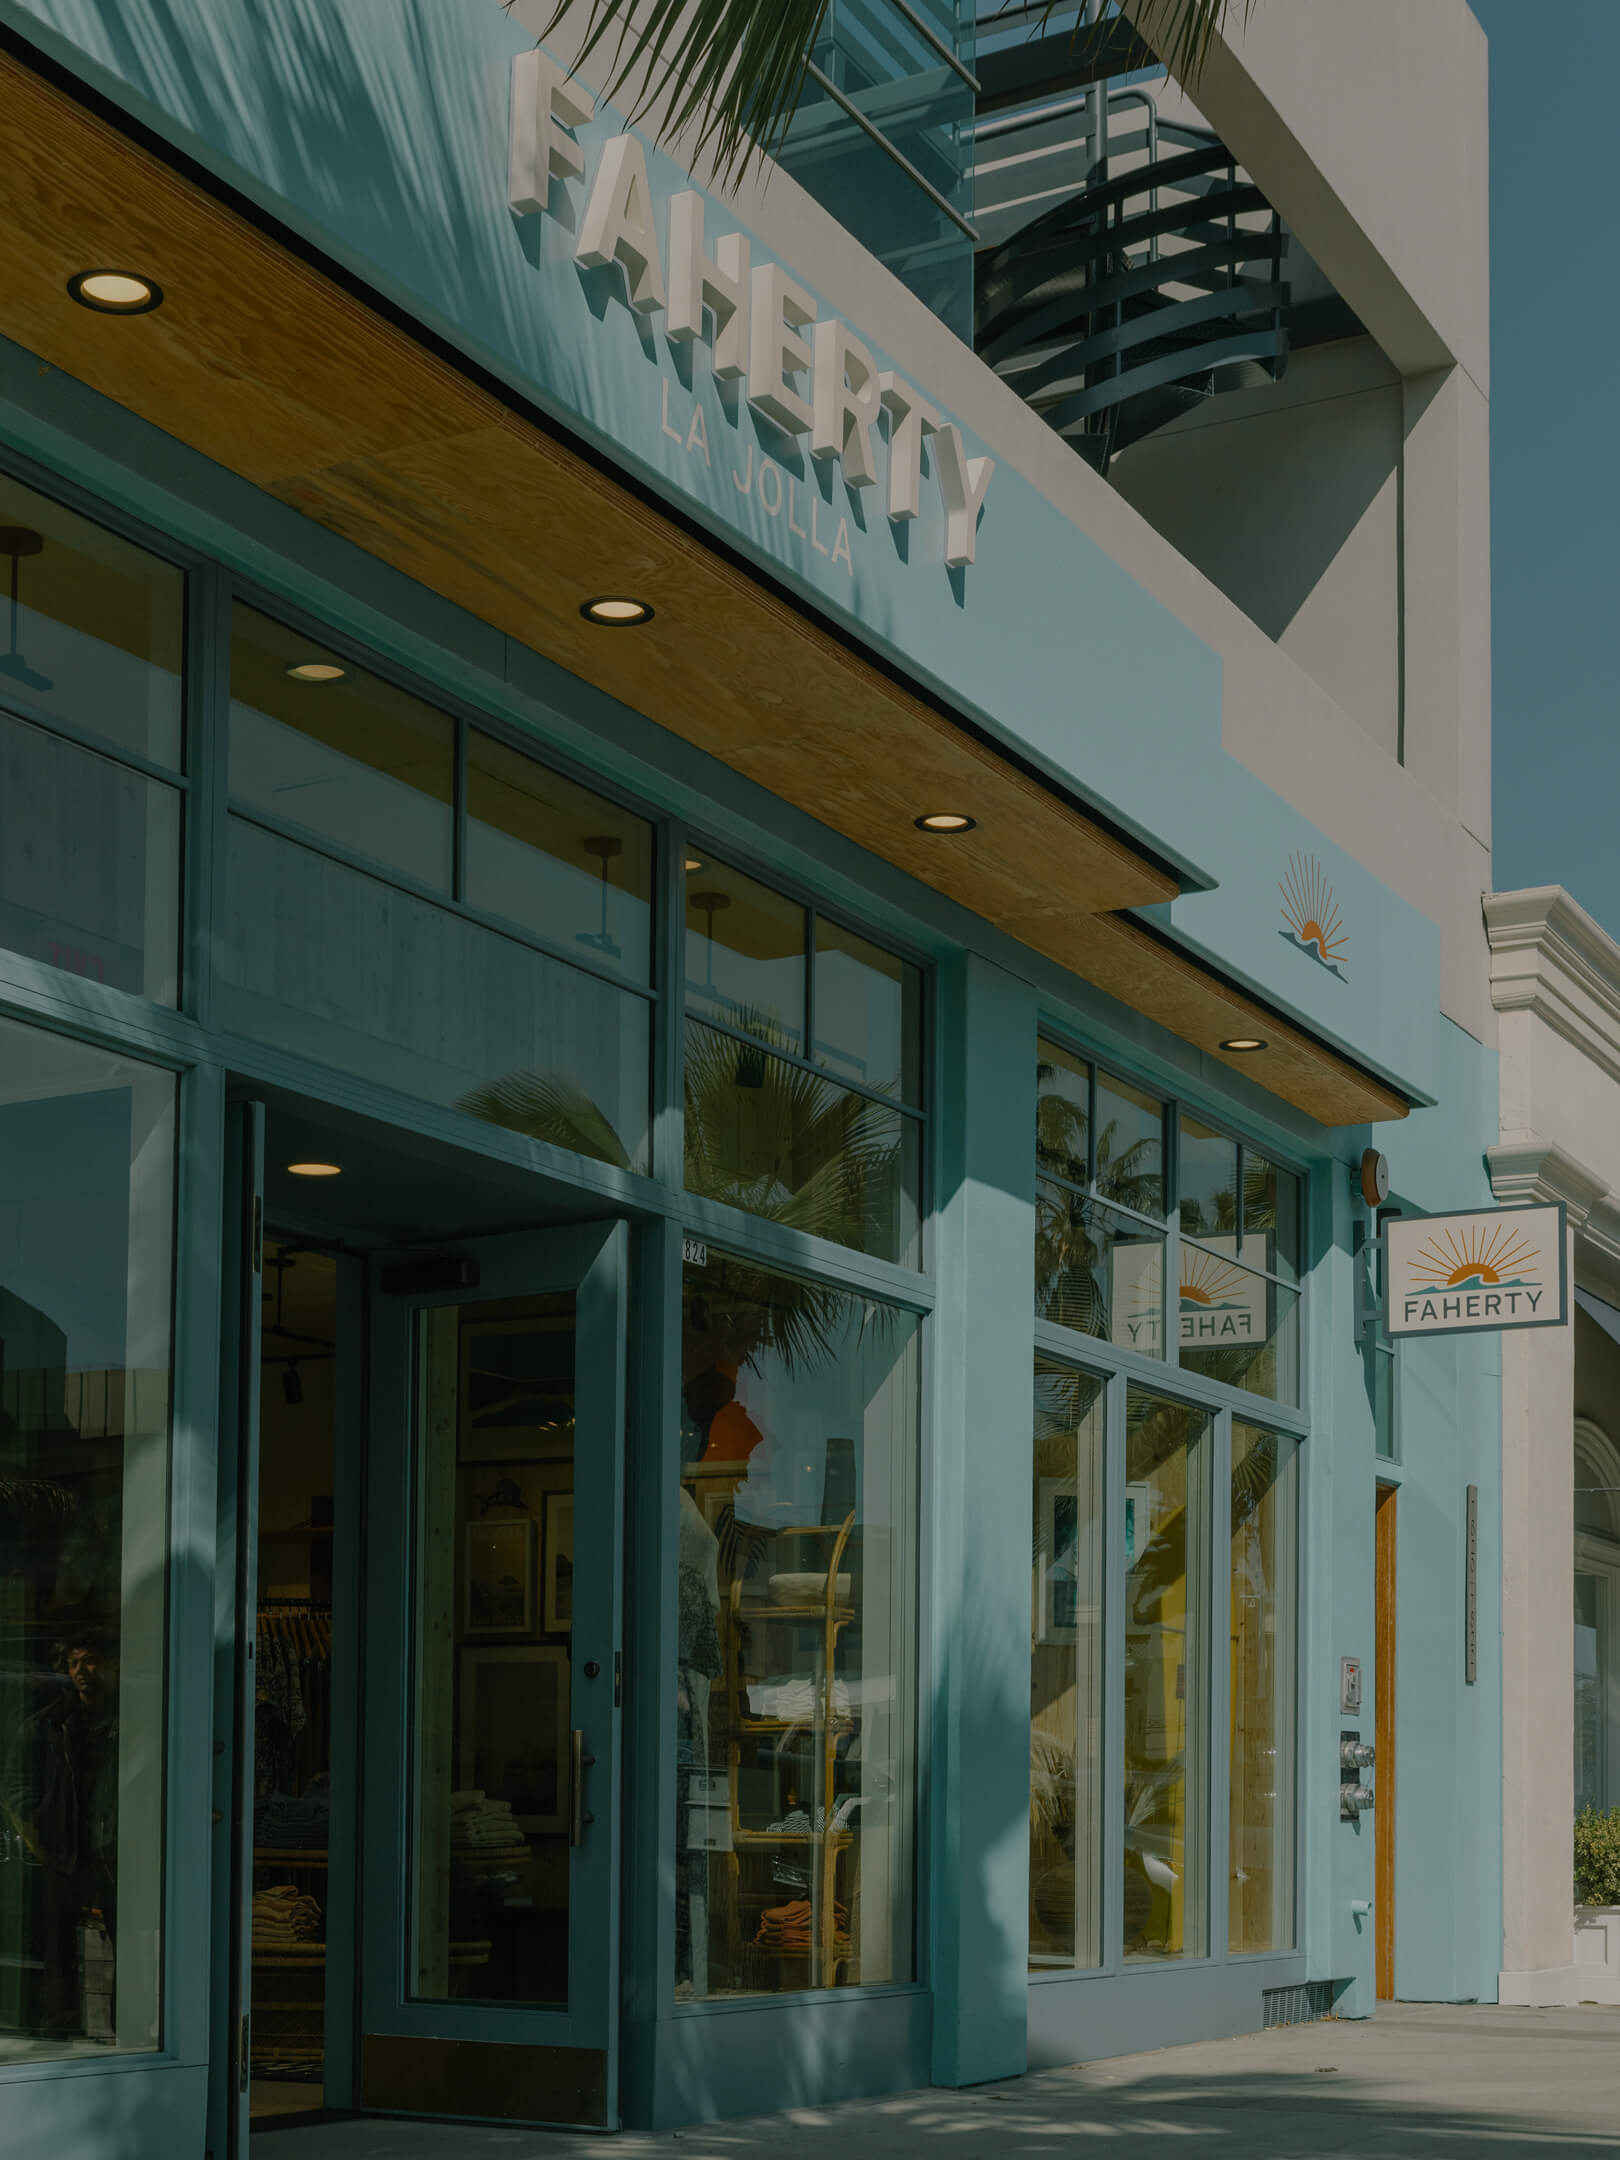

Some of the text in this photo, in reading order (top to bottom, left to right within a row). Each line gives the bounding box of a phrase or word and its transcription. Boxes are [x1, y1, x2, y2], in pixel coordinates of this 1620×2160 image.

[508, 48, 996, 568] FAHERTY
[662, 376, 853, 577] LA JOLLA
[685, 1239, 705, 1265] 824
[1404, 1290, 1543, 1323] FAHERTY
